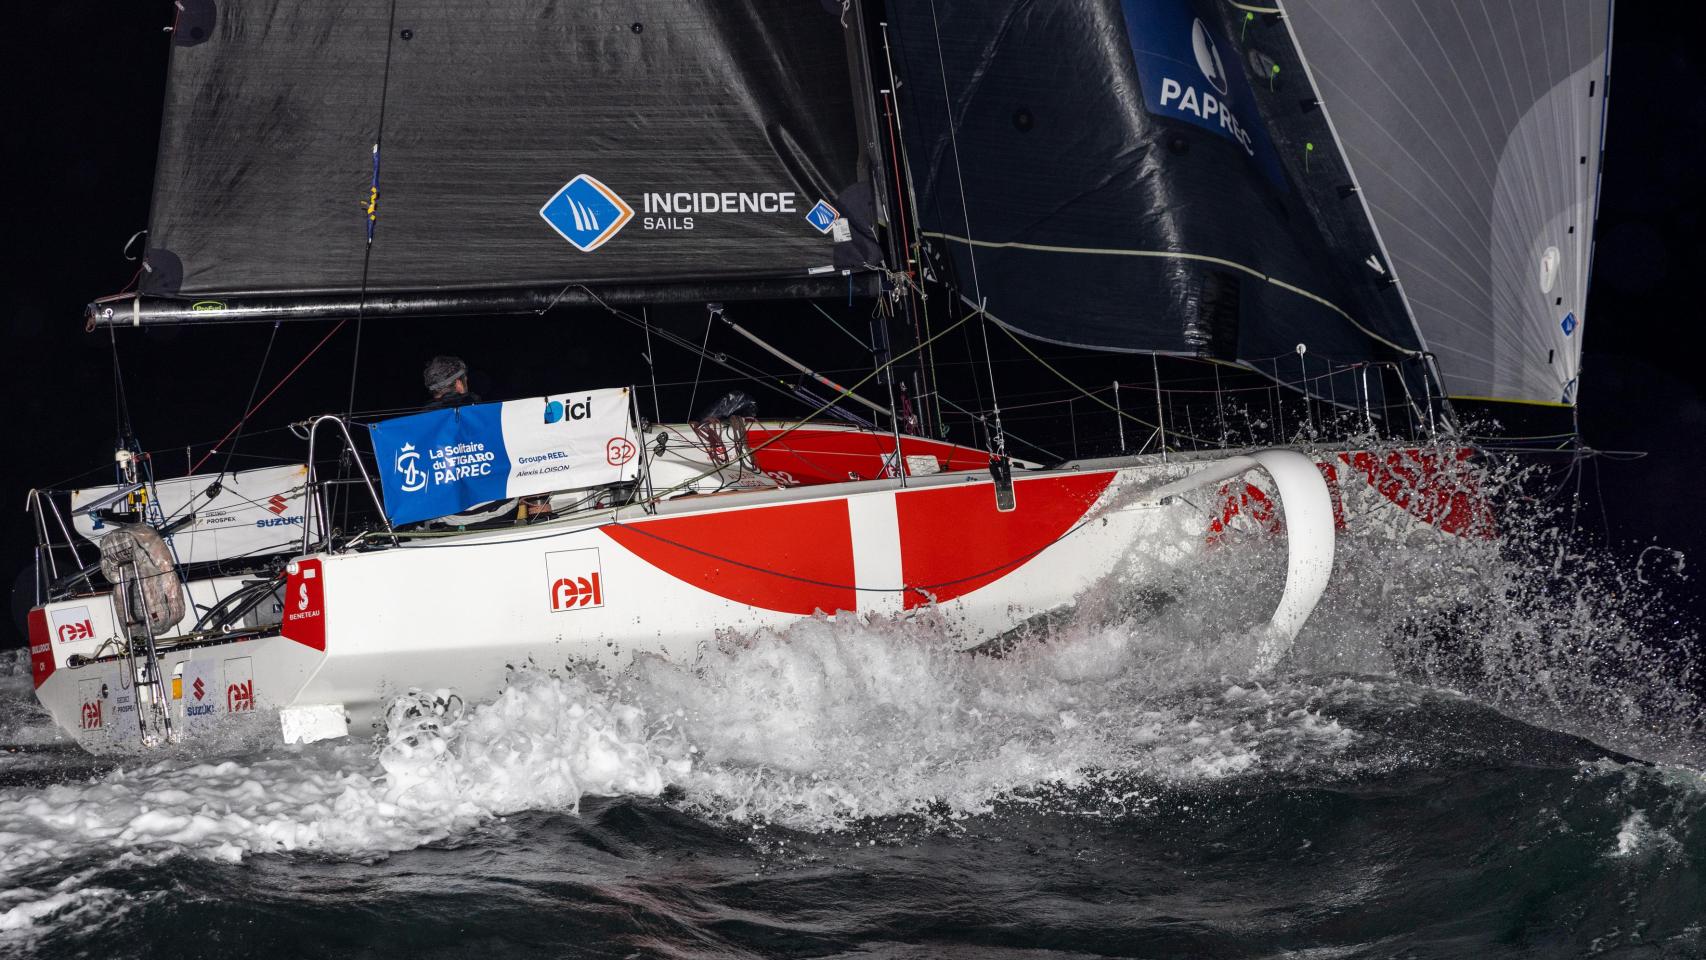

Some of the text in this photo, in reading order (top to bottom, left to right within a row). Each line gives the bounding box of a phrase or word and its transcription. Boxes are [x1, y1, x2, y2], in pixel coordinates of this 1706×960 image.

[1160, 77, 1254, 156] PAPREC
[643, 192, 796, 213] INCIDENCE
[643, 217, 694, 230] SAILS
[429, 441, 484, 460] La Solitaire
[518, 451, 568, 465] Groupe REEL
[610, 444, 631, 460] 32
[432, 452, 495, 470] du FIGARO
[434, 462, 491, 485] PAPREC
[516, 465, 570, 478] Alexis LOISON
[256, 515, 304, 528] SUZUKI
[551, 572, 602, 610] reel
[289, 610, 320, 621] BENETEAU
